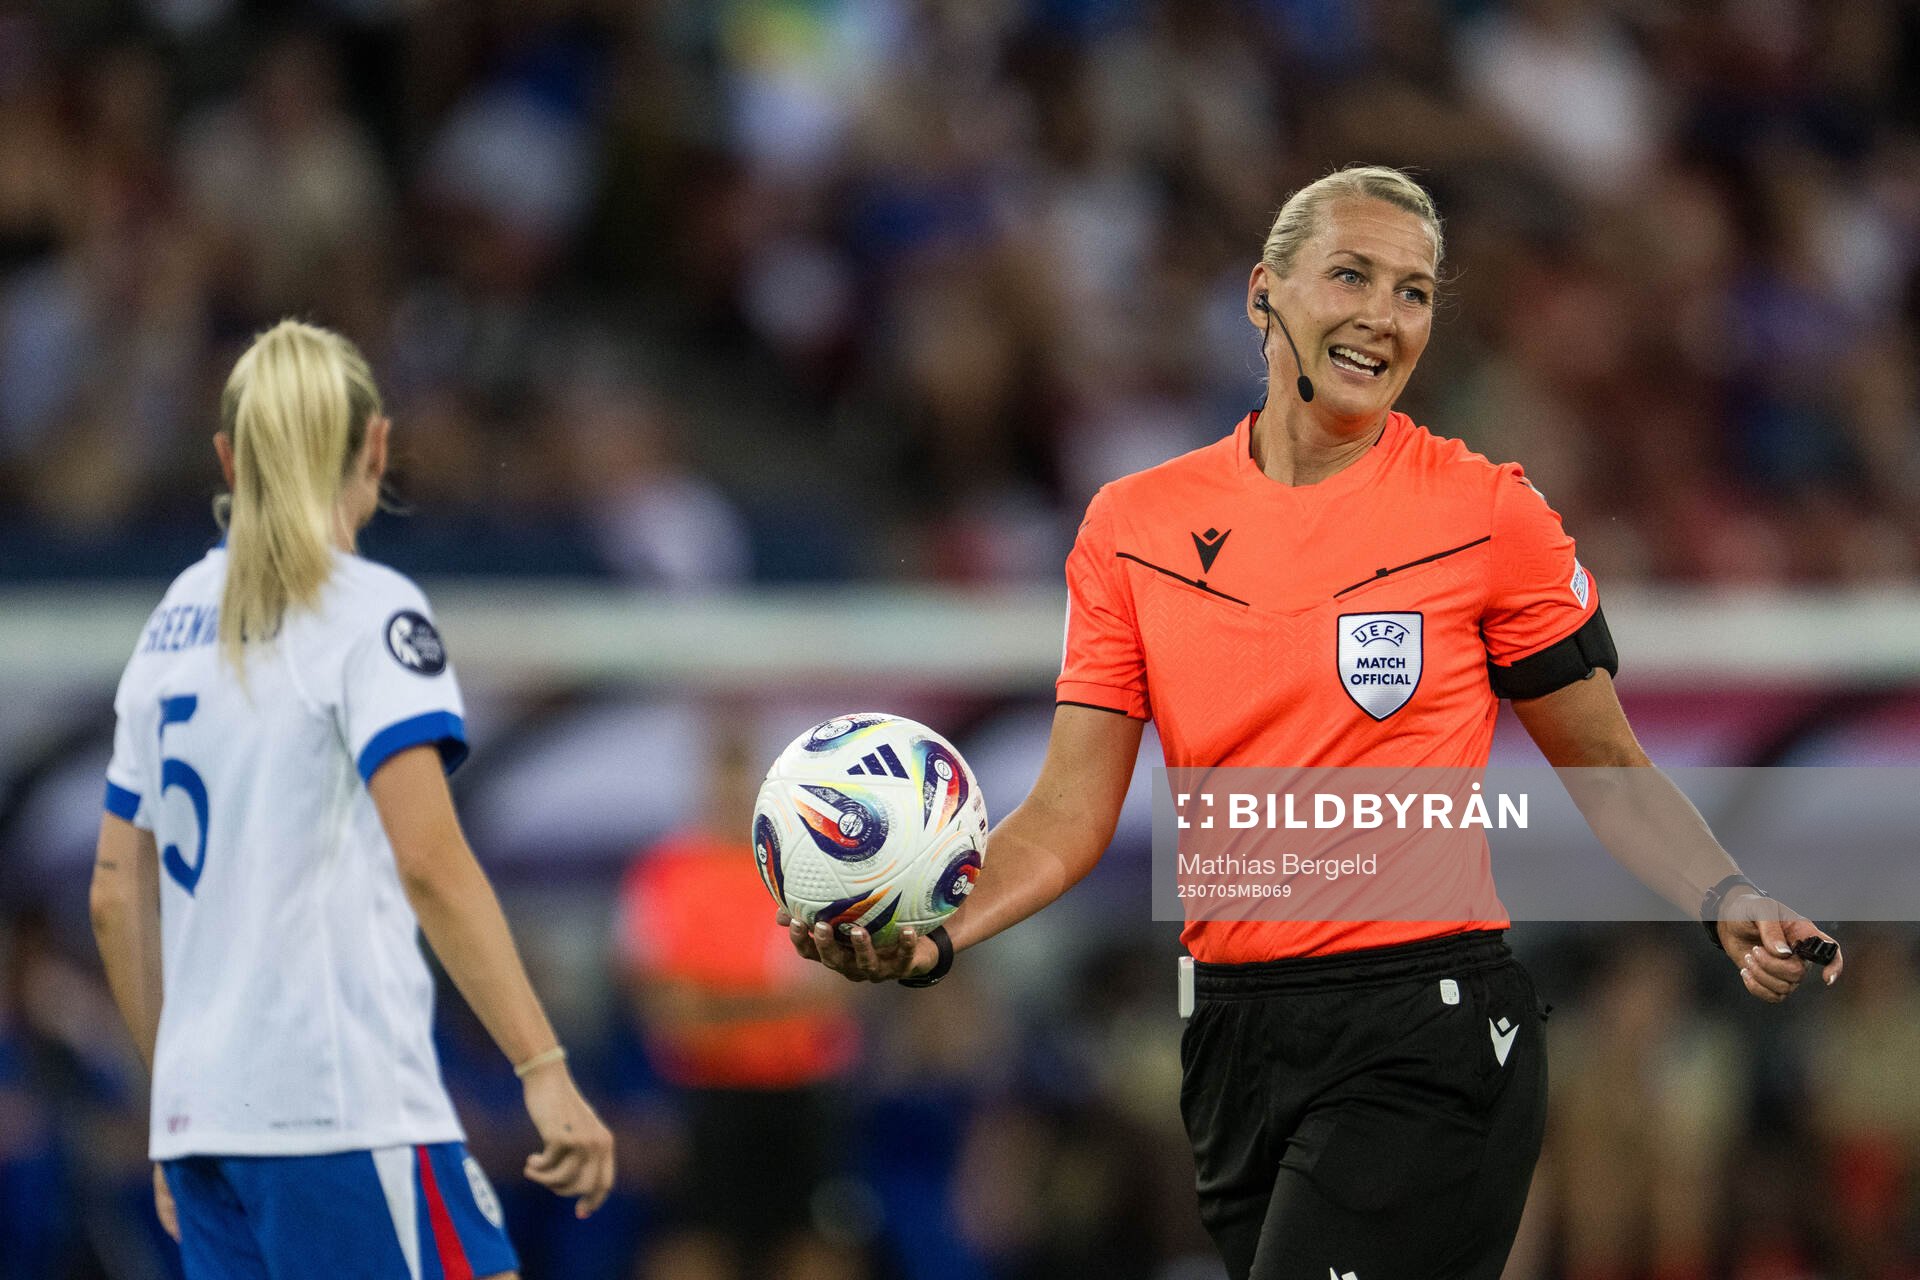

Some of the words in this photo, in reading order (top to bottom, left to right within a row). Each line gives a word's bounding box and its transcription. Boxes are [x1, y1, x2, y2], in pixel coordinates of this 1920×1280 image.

[1355, 625, 1405, 643] UEFA
[1357, 657, 1405, 669] MATCH
[1351, 674, 1411, 685] OFFICIAL
[159, 694, 208, 897] 5
